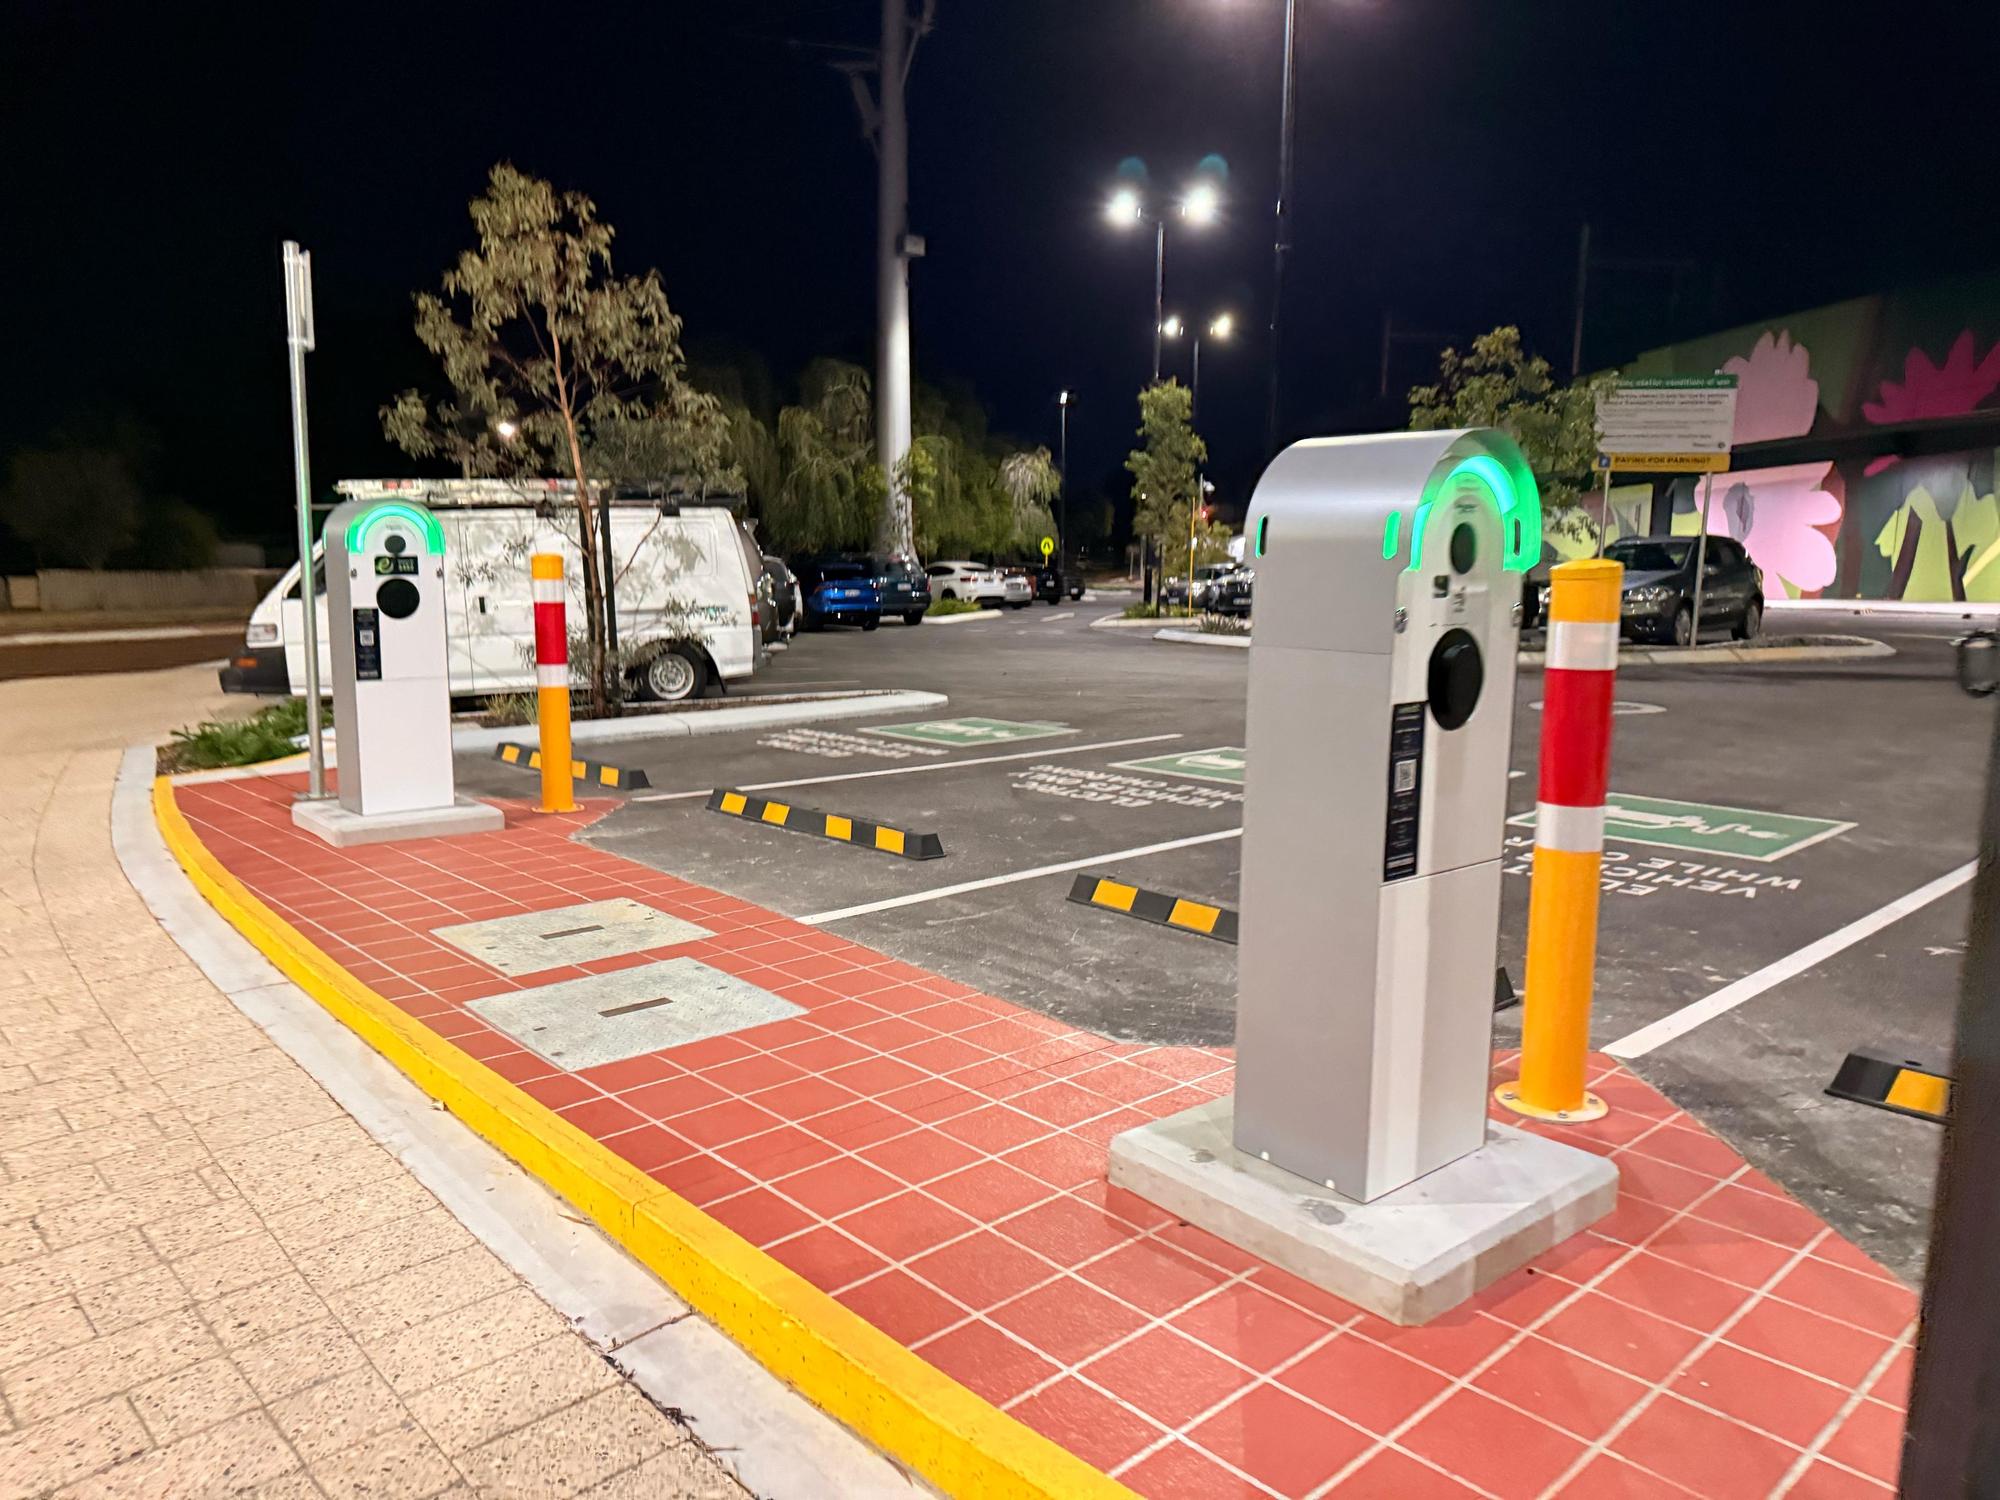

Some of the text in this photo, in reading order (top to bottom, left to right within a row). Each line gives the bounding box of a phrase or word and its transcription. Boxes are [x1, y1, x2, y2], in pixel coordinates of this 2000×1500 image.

[1614, 456, 1645, 464] PAYING
[1647, 456, 1665, 464] FOR
[1638, 857, 1801, 890] WHILE
